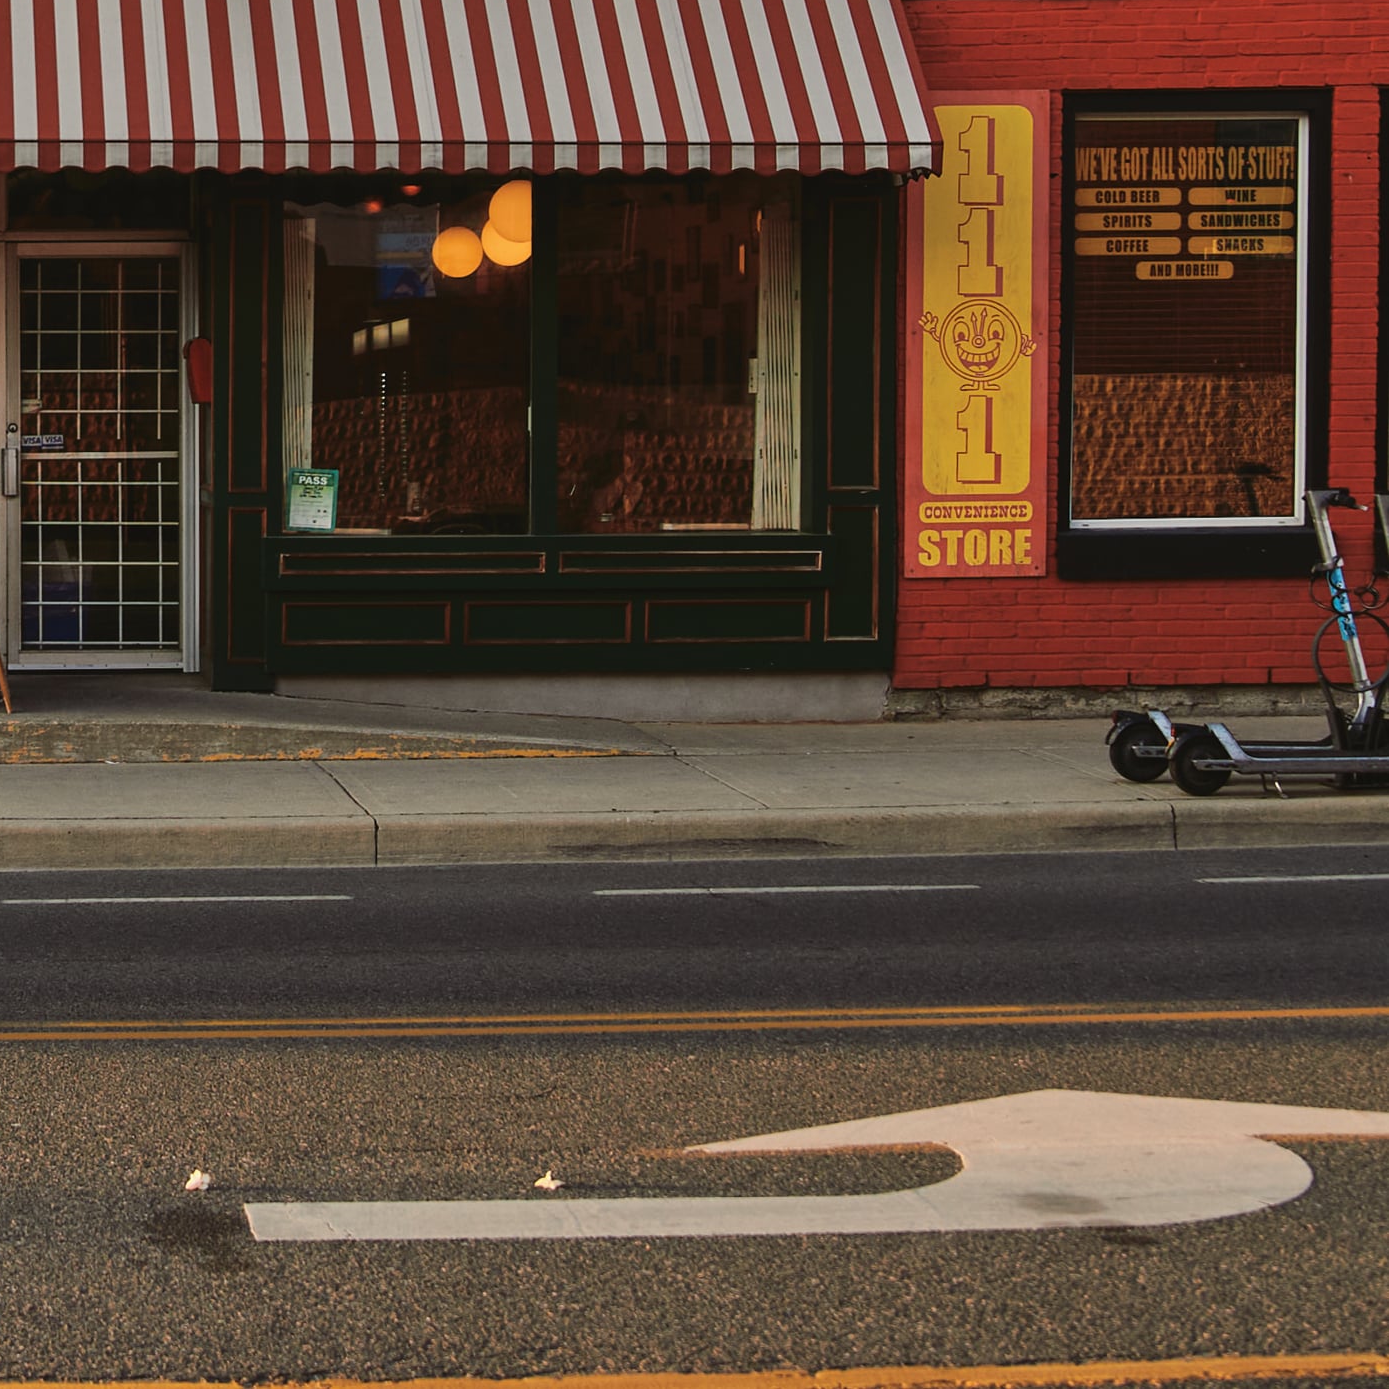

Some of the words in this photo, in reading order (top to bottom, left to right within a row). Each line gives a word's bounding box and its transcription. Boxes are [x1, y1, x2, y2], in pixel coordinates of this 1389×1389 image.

[1075, 147, 1117, 181] WE'VE
[1121, 147, 1149, 181] GOT
[1152, 147, 1175, 180] ALL
[1179, 147, 1224, 181] SORTS
[1228, 147, 1245, 180] OF
[1248, 146, 1295, 180] STUFF!
[1095, 190, 1126, 203] COLD
[1130, 190, 1160, 203] BEER
[1225, 189, 1257, 202] WINE
[1103, 215, 1152, 228] SPIRITS
[1201, 214, 1281, 227] SANDWICHES
[1106, 240, 1149, 252] COFFEE
[1216, 238, 1265, 251] SNACKS
[1150, 264, 1172, 277] AND
[298, 476, 328, 485] PASS
[924, 505, 1028, 519] CONVENIENCE
[918, 529, 1032, 566] STORE
